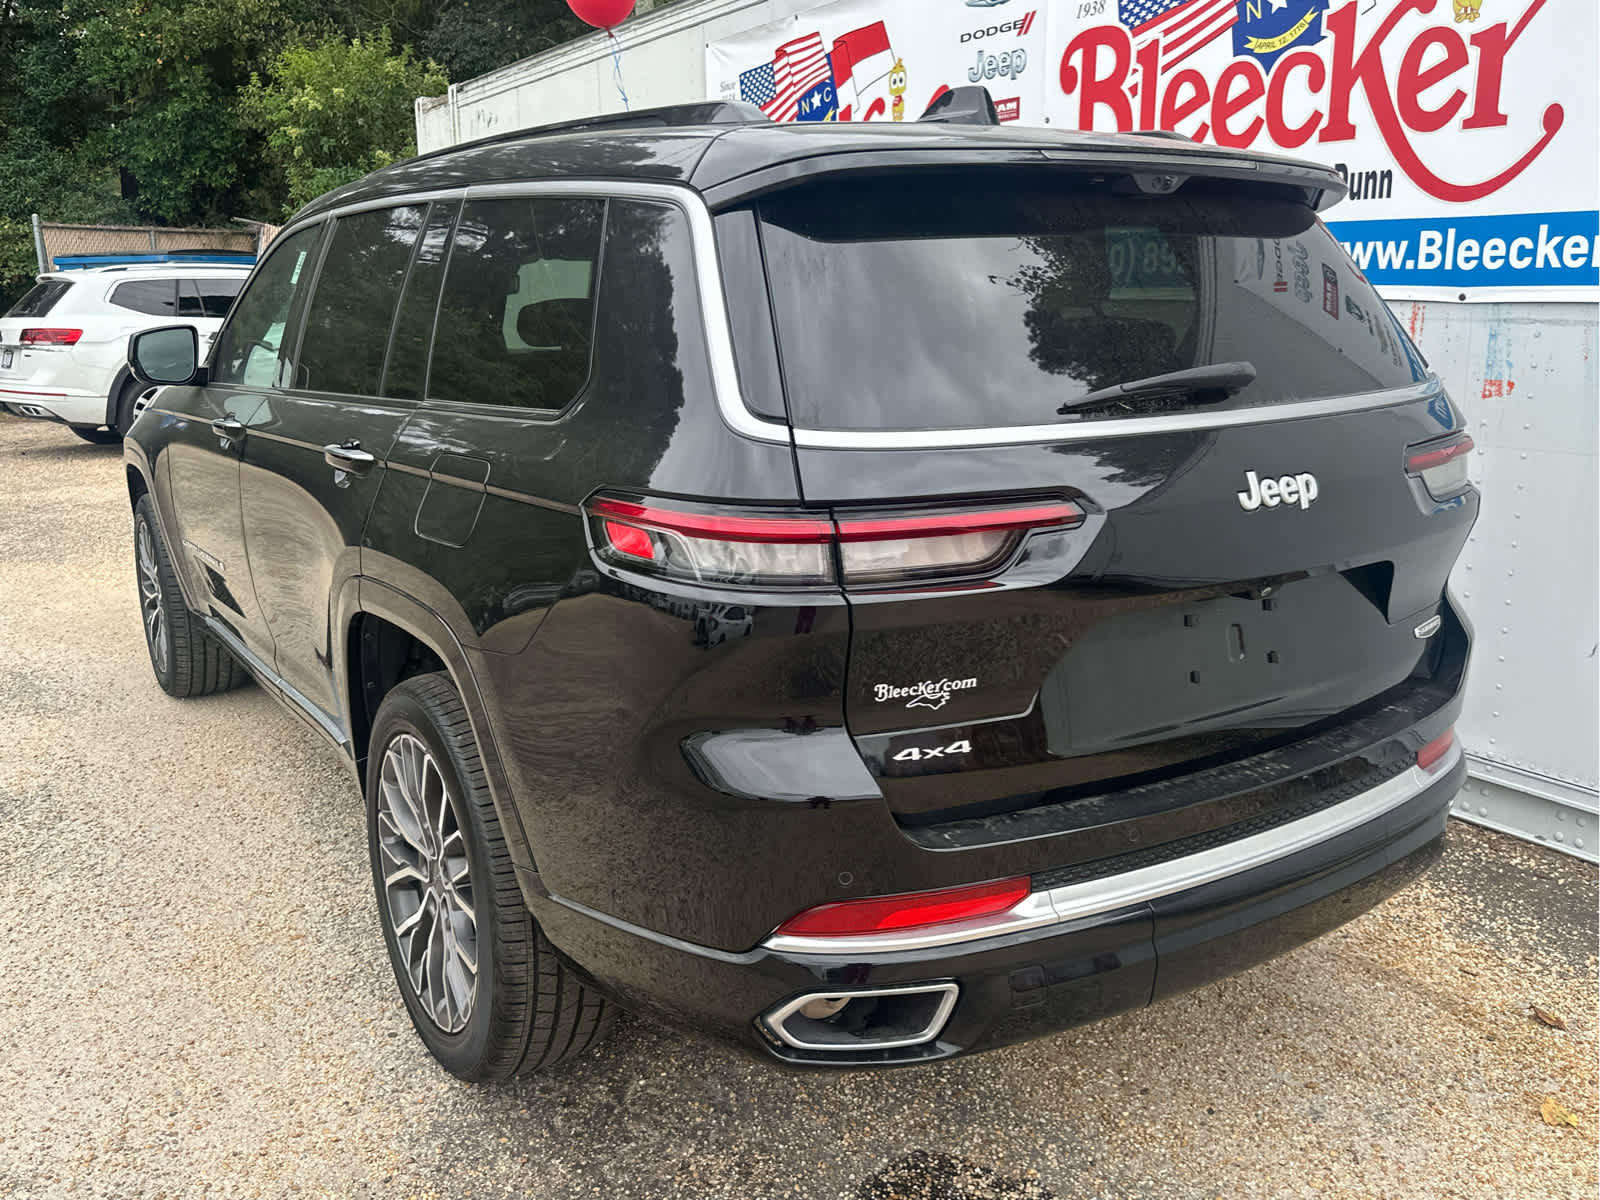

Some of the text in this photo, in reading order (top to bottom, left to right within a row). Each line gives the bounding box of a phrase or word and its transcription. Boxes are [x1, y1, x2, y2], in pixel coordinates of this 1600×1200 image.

[1076, 0, 1106, 19] 1938
[960, 18, 1025, 43] DODGE
[968, 48, 1027, 83] Jeep
[1237, 470, 1318, 511] Jeep
[891, 739, 973, 761] 4x4
